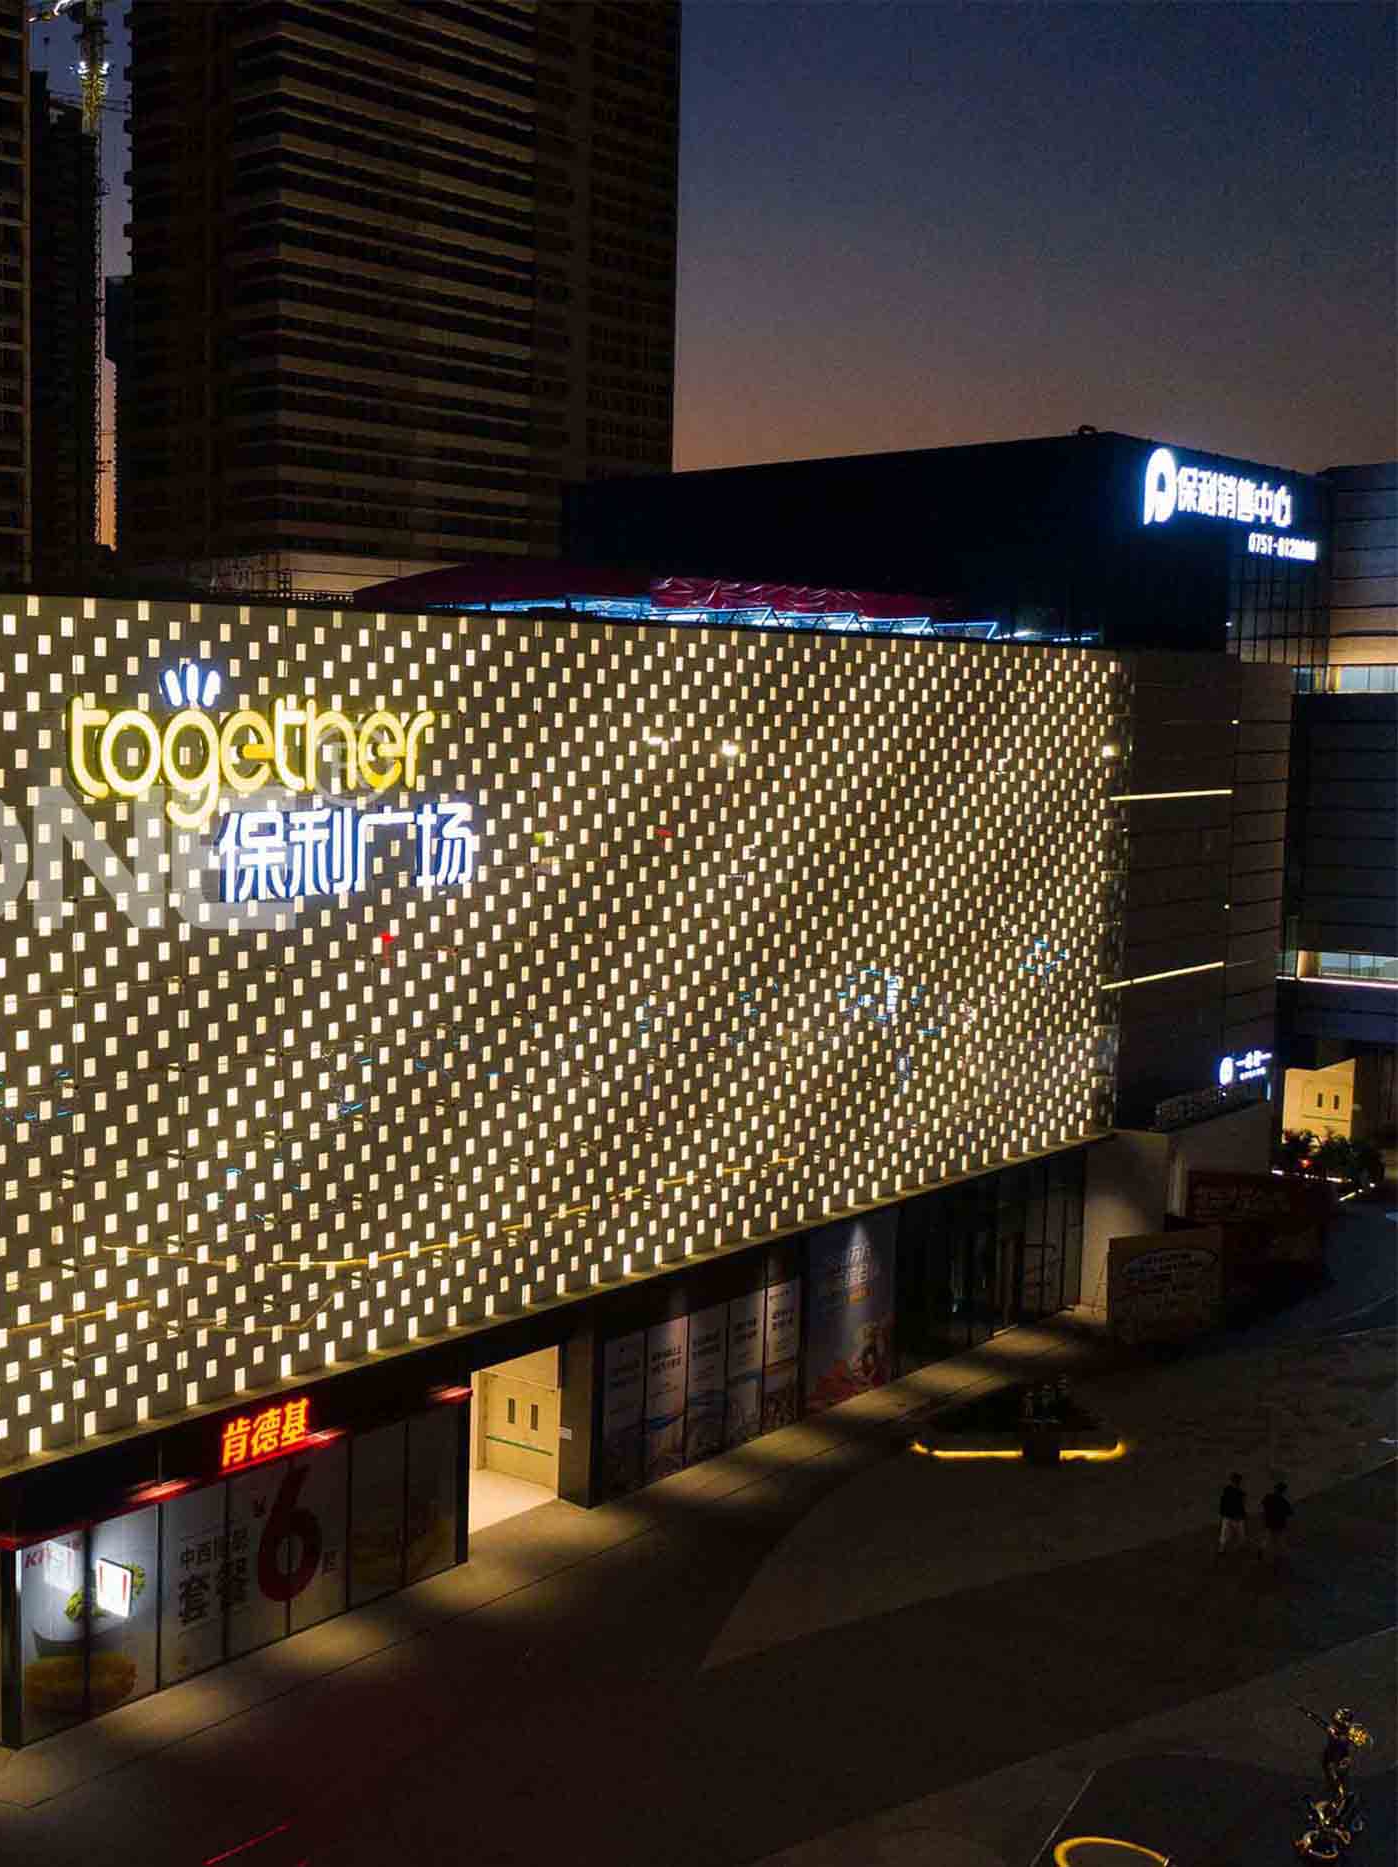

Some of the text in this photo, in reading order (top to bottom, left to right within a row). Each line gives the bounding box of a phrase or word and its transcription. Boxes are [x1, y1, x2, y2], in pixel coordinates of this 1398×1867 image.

[70, 696, 435, 829] together
[218, 802, 476, 903] 保利广场
[222, 1397, 308, 1467] 肯德基
